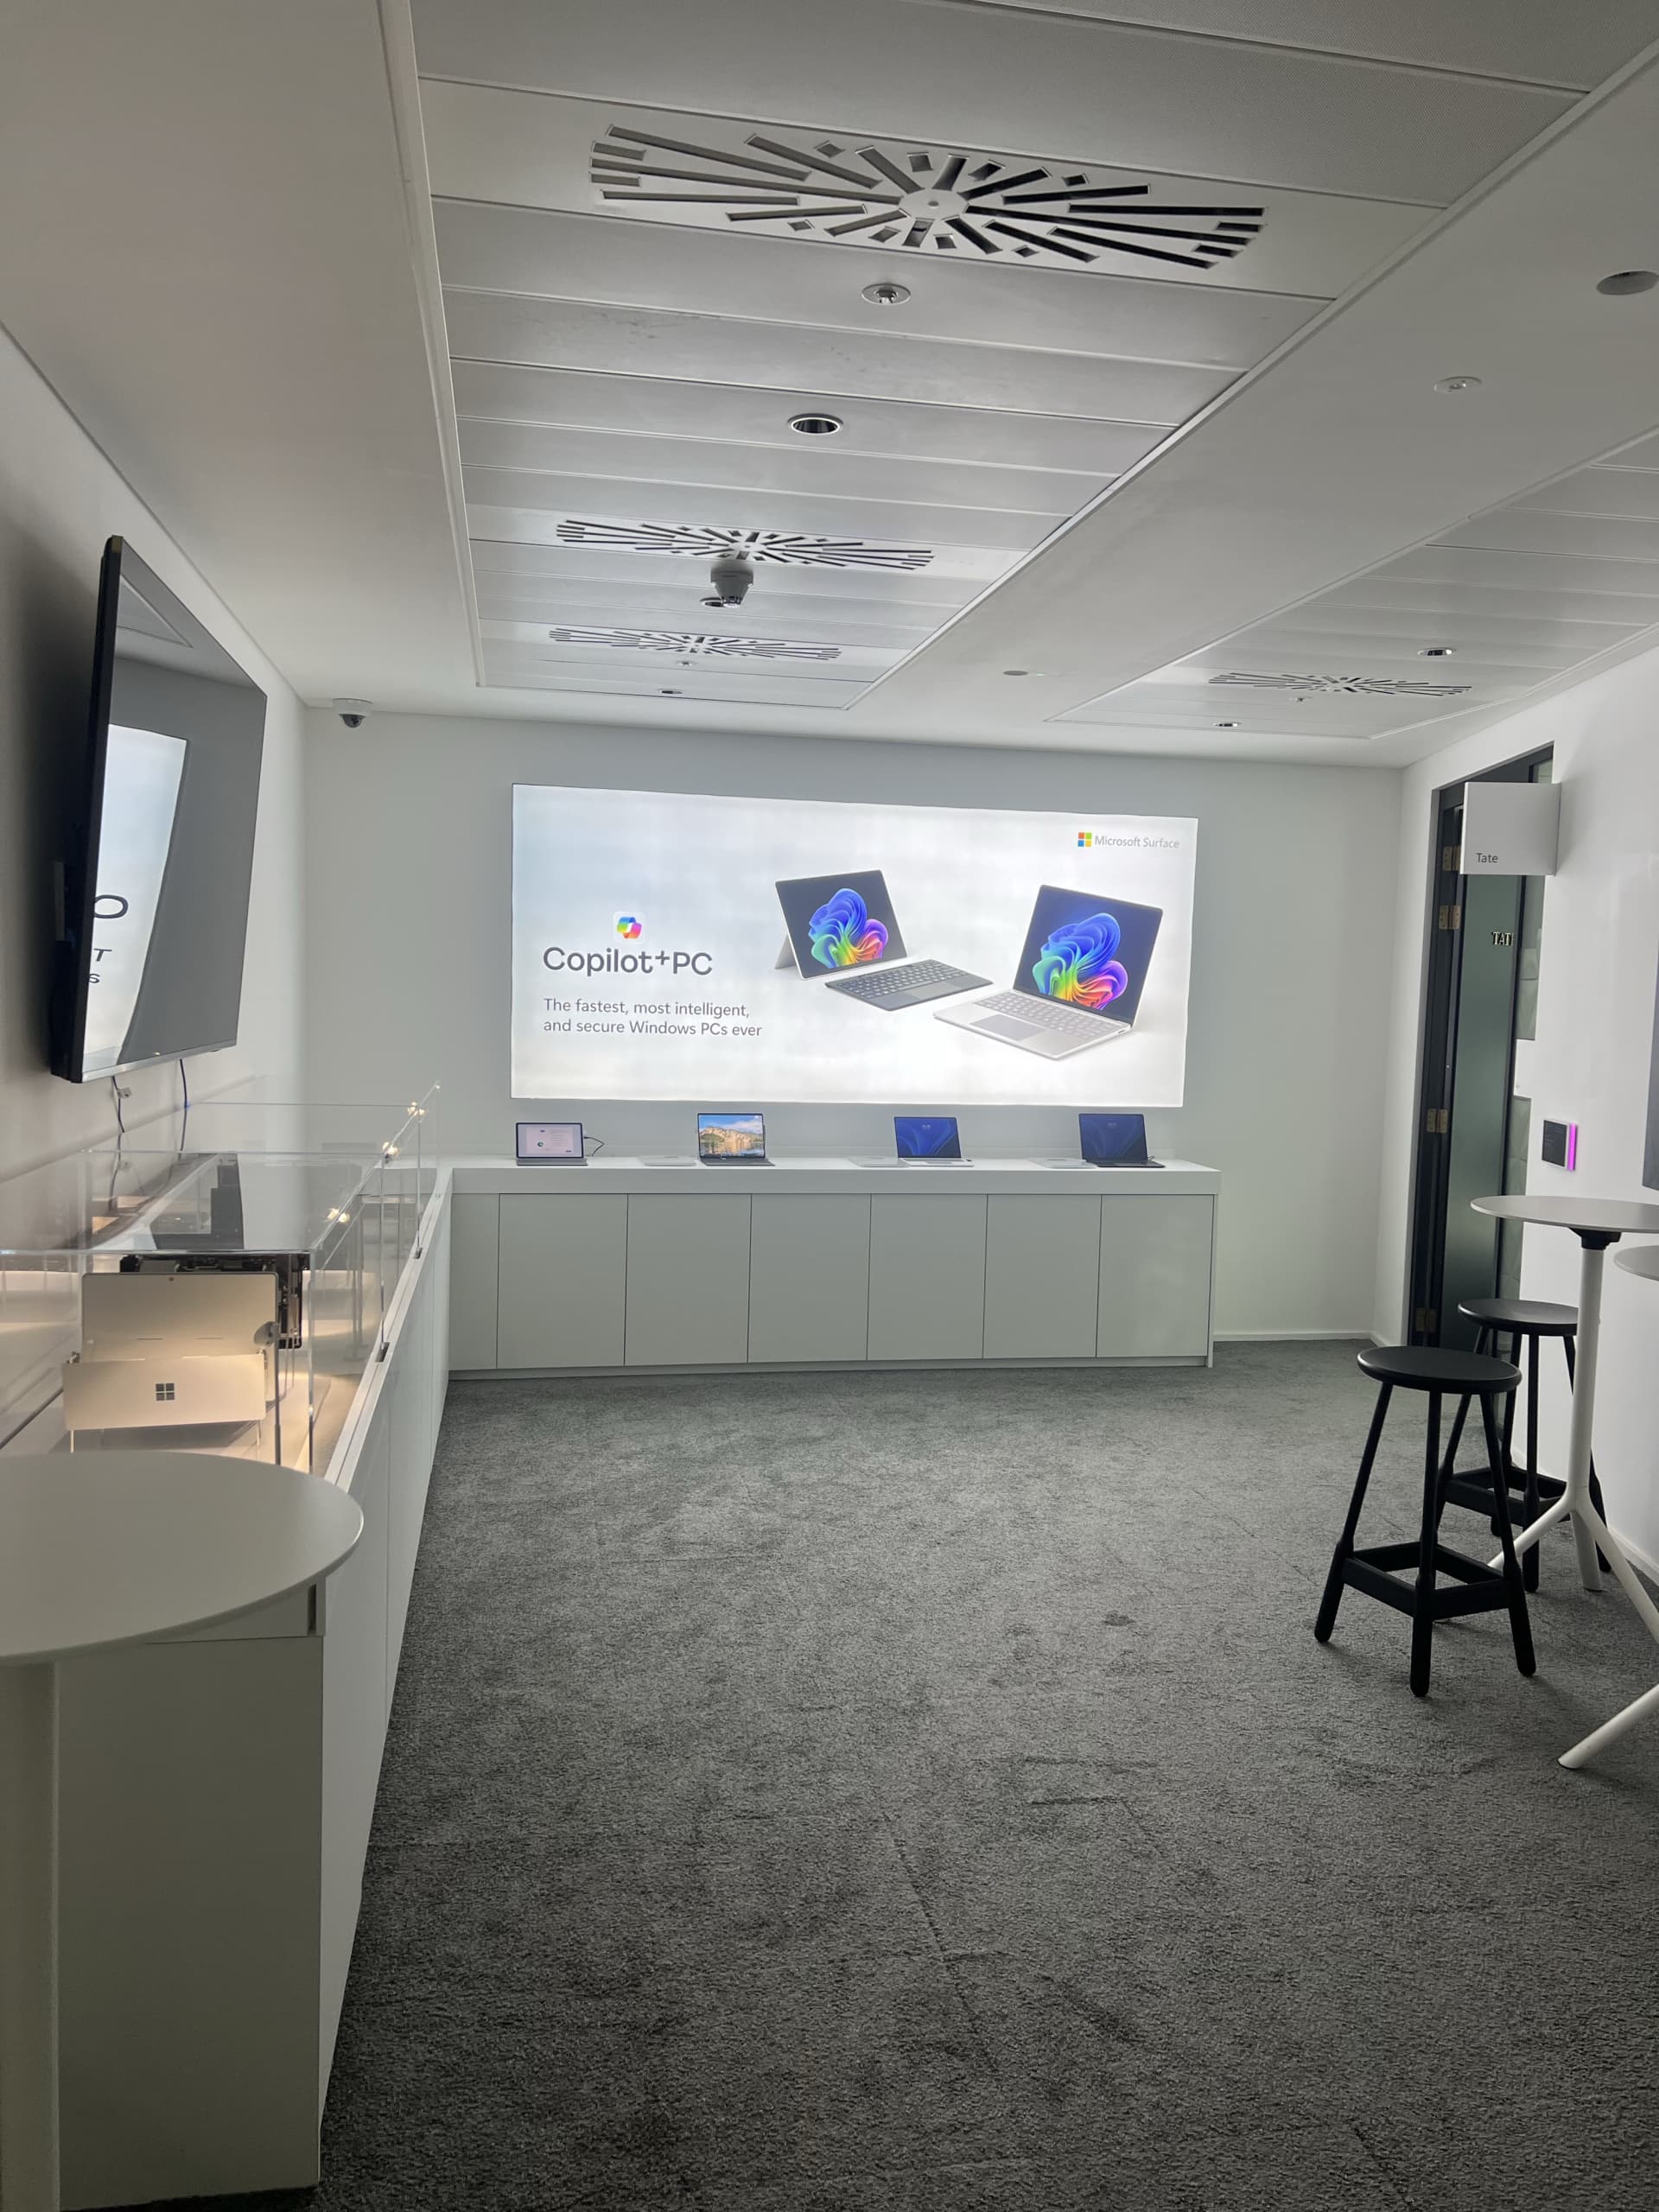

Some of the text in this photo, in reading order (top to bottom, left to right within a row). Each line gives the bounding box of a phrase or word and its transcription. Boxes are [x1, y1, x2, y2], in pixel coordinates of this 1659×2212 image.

[1095, 836, 1180, 849] Microsoft Surface
[1476, 852, 1499, 863] Tate
[543, 998, 750, 1019] The fastest, most intelligent,
[543, 1019, 763, 1037] and secure Windows PCs ever
